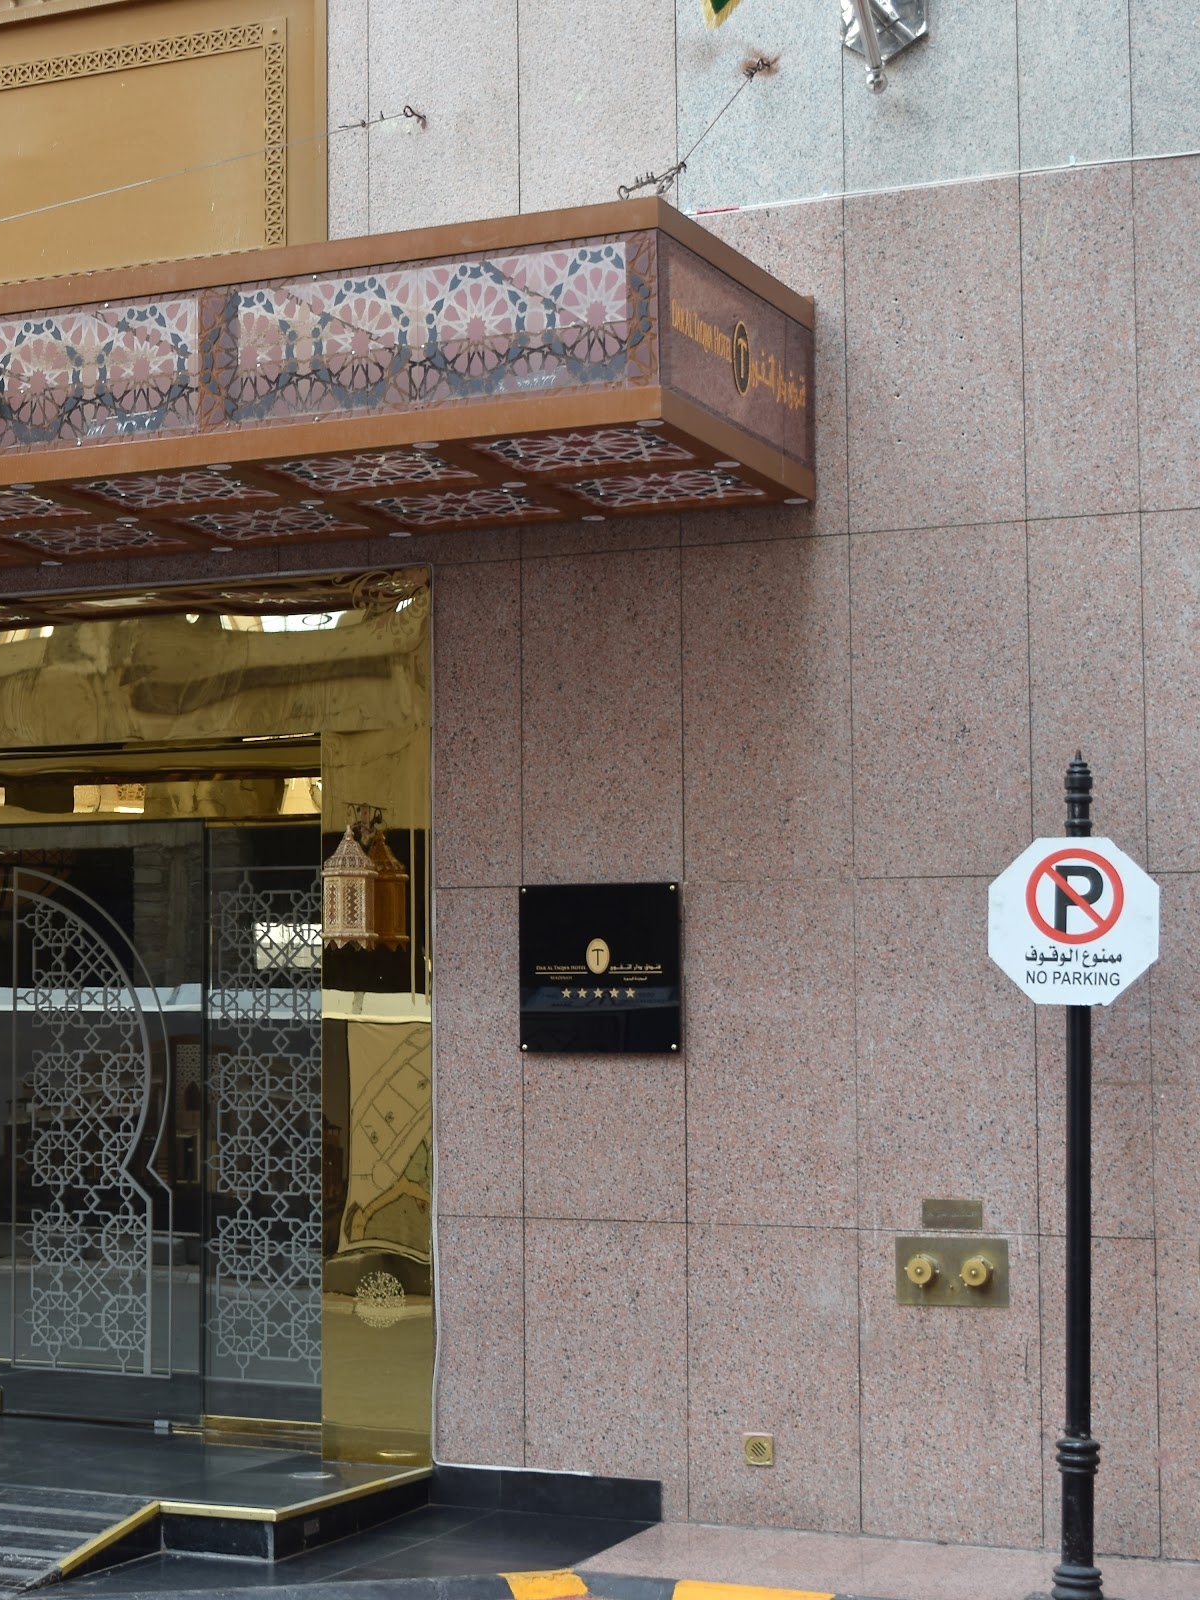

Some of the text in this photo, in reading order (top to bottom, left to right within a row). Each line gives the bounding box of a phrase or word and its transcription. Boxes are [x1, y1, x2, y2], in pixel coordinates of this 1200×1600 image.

[1025, 945, 1123, 968] ممنوع الوقوف
[1026, 970, 1120, 986] NO PARKING
